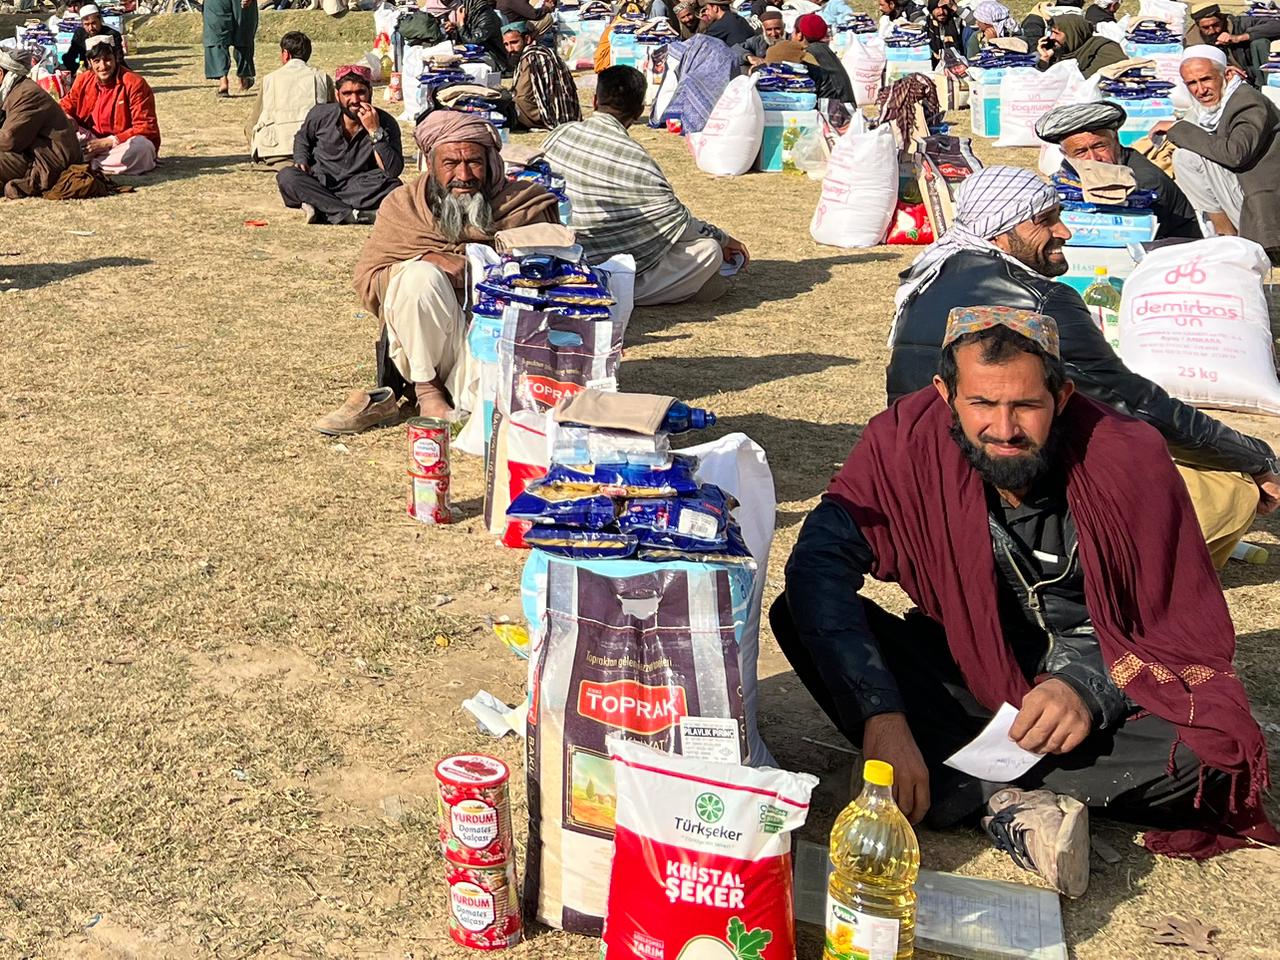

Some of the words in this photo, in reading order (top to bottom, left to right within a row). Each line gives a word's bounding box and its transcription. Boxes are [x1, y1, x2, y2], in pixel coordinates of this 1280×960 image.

[1174, 316, 1203, 328] un
[1177, 366, 1196, 378] 25
[1200, 367, 1218, 382] kg
[586, 692, 679, 720] TOPRAK
[453, 812, 494, 824] YURDUM
[458, 824, 492, 835] Domates
[674, 816, 743, 841] Türkşeker
[462, 832, 489, 844] Salçası
[666, 860, 745, 888] KRİSTAL
[452, 893, 490, 908] YURDUM
[665, 877, 745, 909] ŞEKER
[456, 904, 488, 918] Domates
